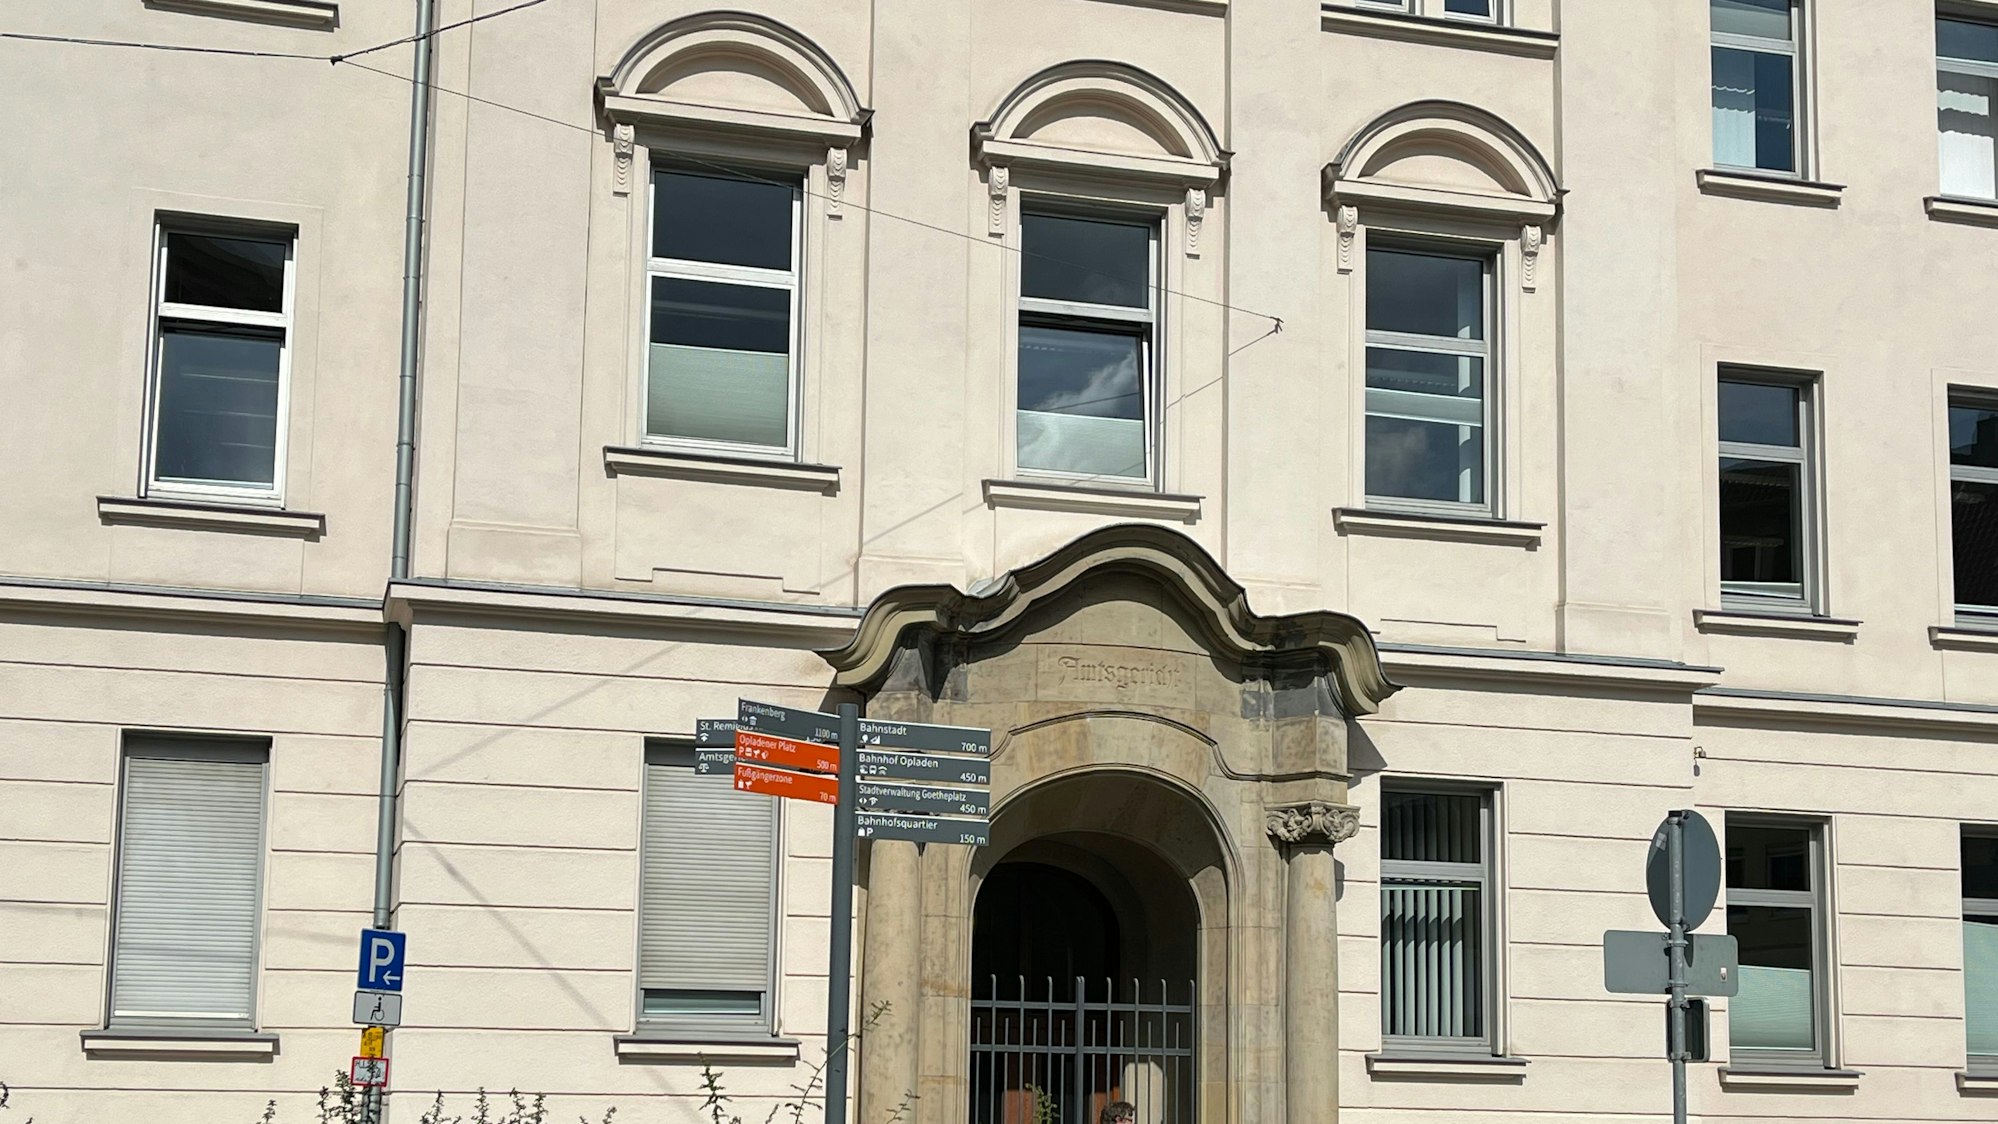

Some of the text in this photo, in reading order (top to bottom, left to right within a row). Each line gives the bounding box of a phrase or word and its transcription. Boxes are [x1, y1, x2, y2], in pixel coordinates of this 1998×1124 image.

[741, 702, 786, 722] Frankenberg
[700, 721, 711, 731] St.
[860, 723, 907, 735] Bahnstadt
[815, 728, 830, 739] 1100
[740, 734, 796, 753] Opladener Platz
[961, 742, 976, 752] 700
[817, 759, 837, 771] 500 m
[859, 753, 939, 768] Bahnhof Opladen
[738, 766, 793, 784] Fußgängerzone
[960, 773, 976, 782] 450
[820, 792, 828, 801] 70
[859, 785, 967, 802] Stadtverwaltung Goetheplatz
[960, 805, 976, 814] 450
[857, 816, 938, 830] Bahnhofsquartier
[959, 834, 986, 844] 150 m
[368, 937, 395, 982] P
